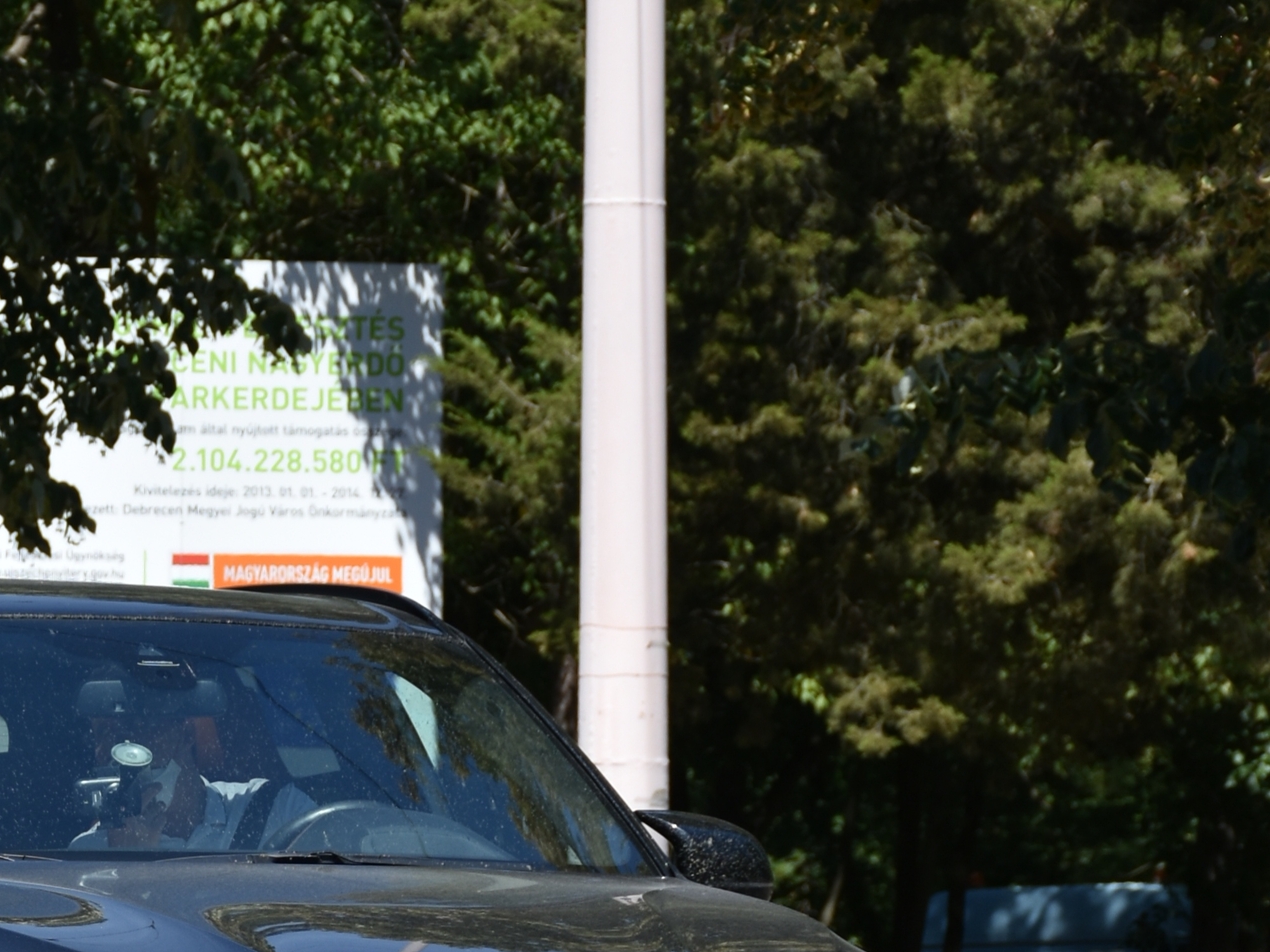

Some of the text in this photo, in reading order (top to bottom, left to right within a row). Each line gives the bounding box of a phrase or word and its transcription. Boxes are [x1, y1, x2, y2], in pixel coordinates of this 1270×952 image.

[171, 349, 237, 374] CENI
[170, 381, 404, 413] ARKERDEJÉBEN
[172, 447, 361, 474] 2.104.228.580
[134, 483, 201, 497] Kivitelezés
[243, 485, 273, 498] 2013.
[124, 503, 183, 516] Debrecen
[188, 504, 231, 519] Megyei
[224, 562, 393, 583] MAGYARORSZÁG MEGÚJUL
